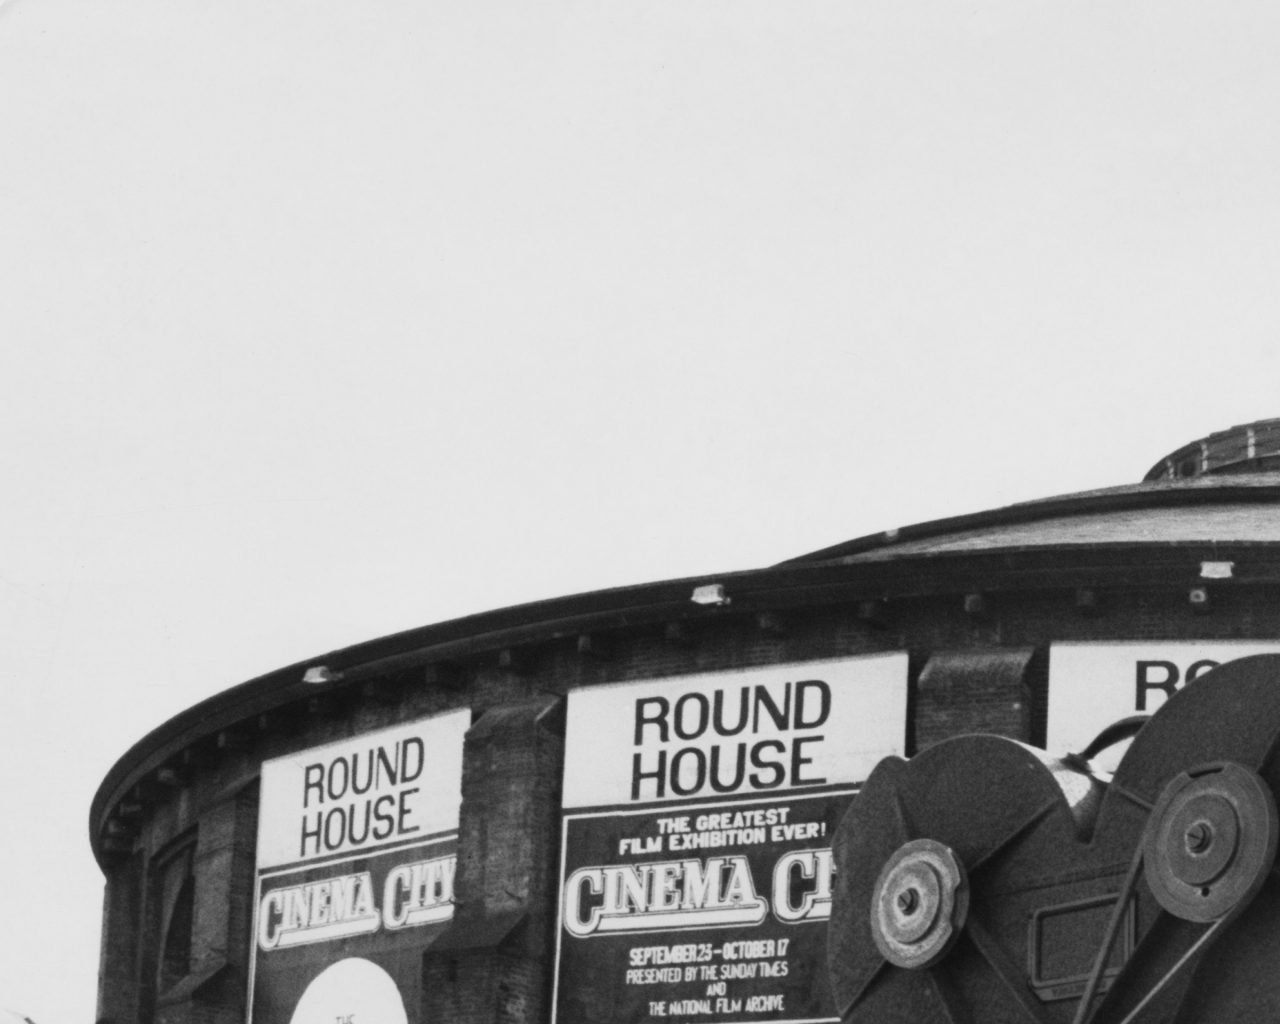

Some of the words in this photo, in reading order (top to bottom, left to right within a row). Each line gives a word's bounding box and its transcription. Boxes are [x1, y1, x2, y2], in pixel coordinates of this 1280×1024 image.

[634, 680, 832, 746] ROUND
[304, 737, 424, 808] ROUND
[631, 736, 827, 800] HOUSE
[301, 788, 420, 857] HOUSE
[619, 836, 662, 856] FILM
[669, 828, 766, 850] EXHIBITION
[771, 822, 826, 842] EVER!
[657, 816, 691, 834] THE
[696, 808, 790, 831] GREATEST
[258, 871, 381, 951] CINEMA
[382, 852, 458, 931] CITY
[564, 856, 768, 938] CINEMA
[626, 968, 682, 984] PRESENTED
[685, 966, 698, 982] BY
[700, 965, 718, 980] THE
[720, 962, 758, 980] SUNDAY
[760, 961, 788, 978] TIMES
[630, 944, 696, 966] SEPTEMBER
[776, 938, 790, 956] 17
[649, 1002, 666, 1016] THE
[669, 1000, 712, 1015] NATIONAL
[716, 998, 742, 1013] FILM
[745, 994, 784, 1012] ARCHIVE
[706, 982, 726, 996] AND
